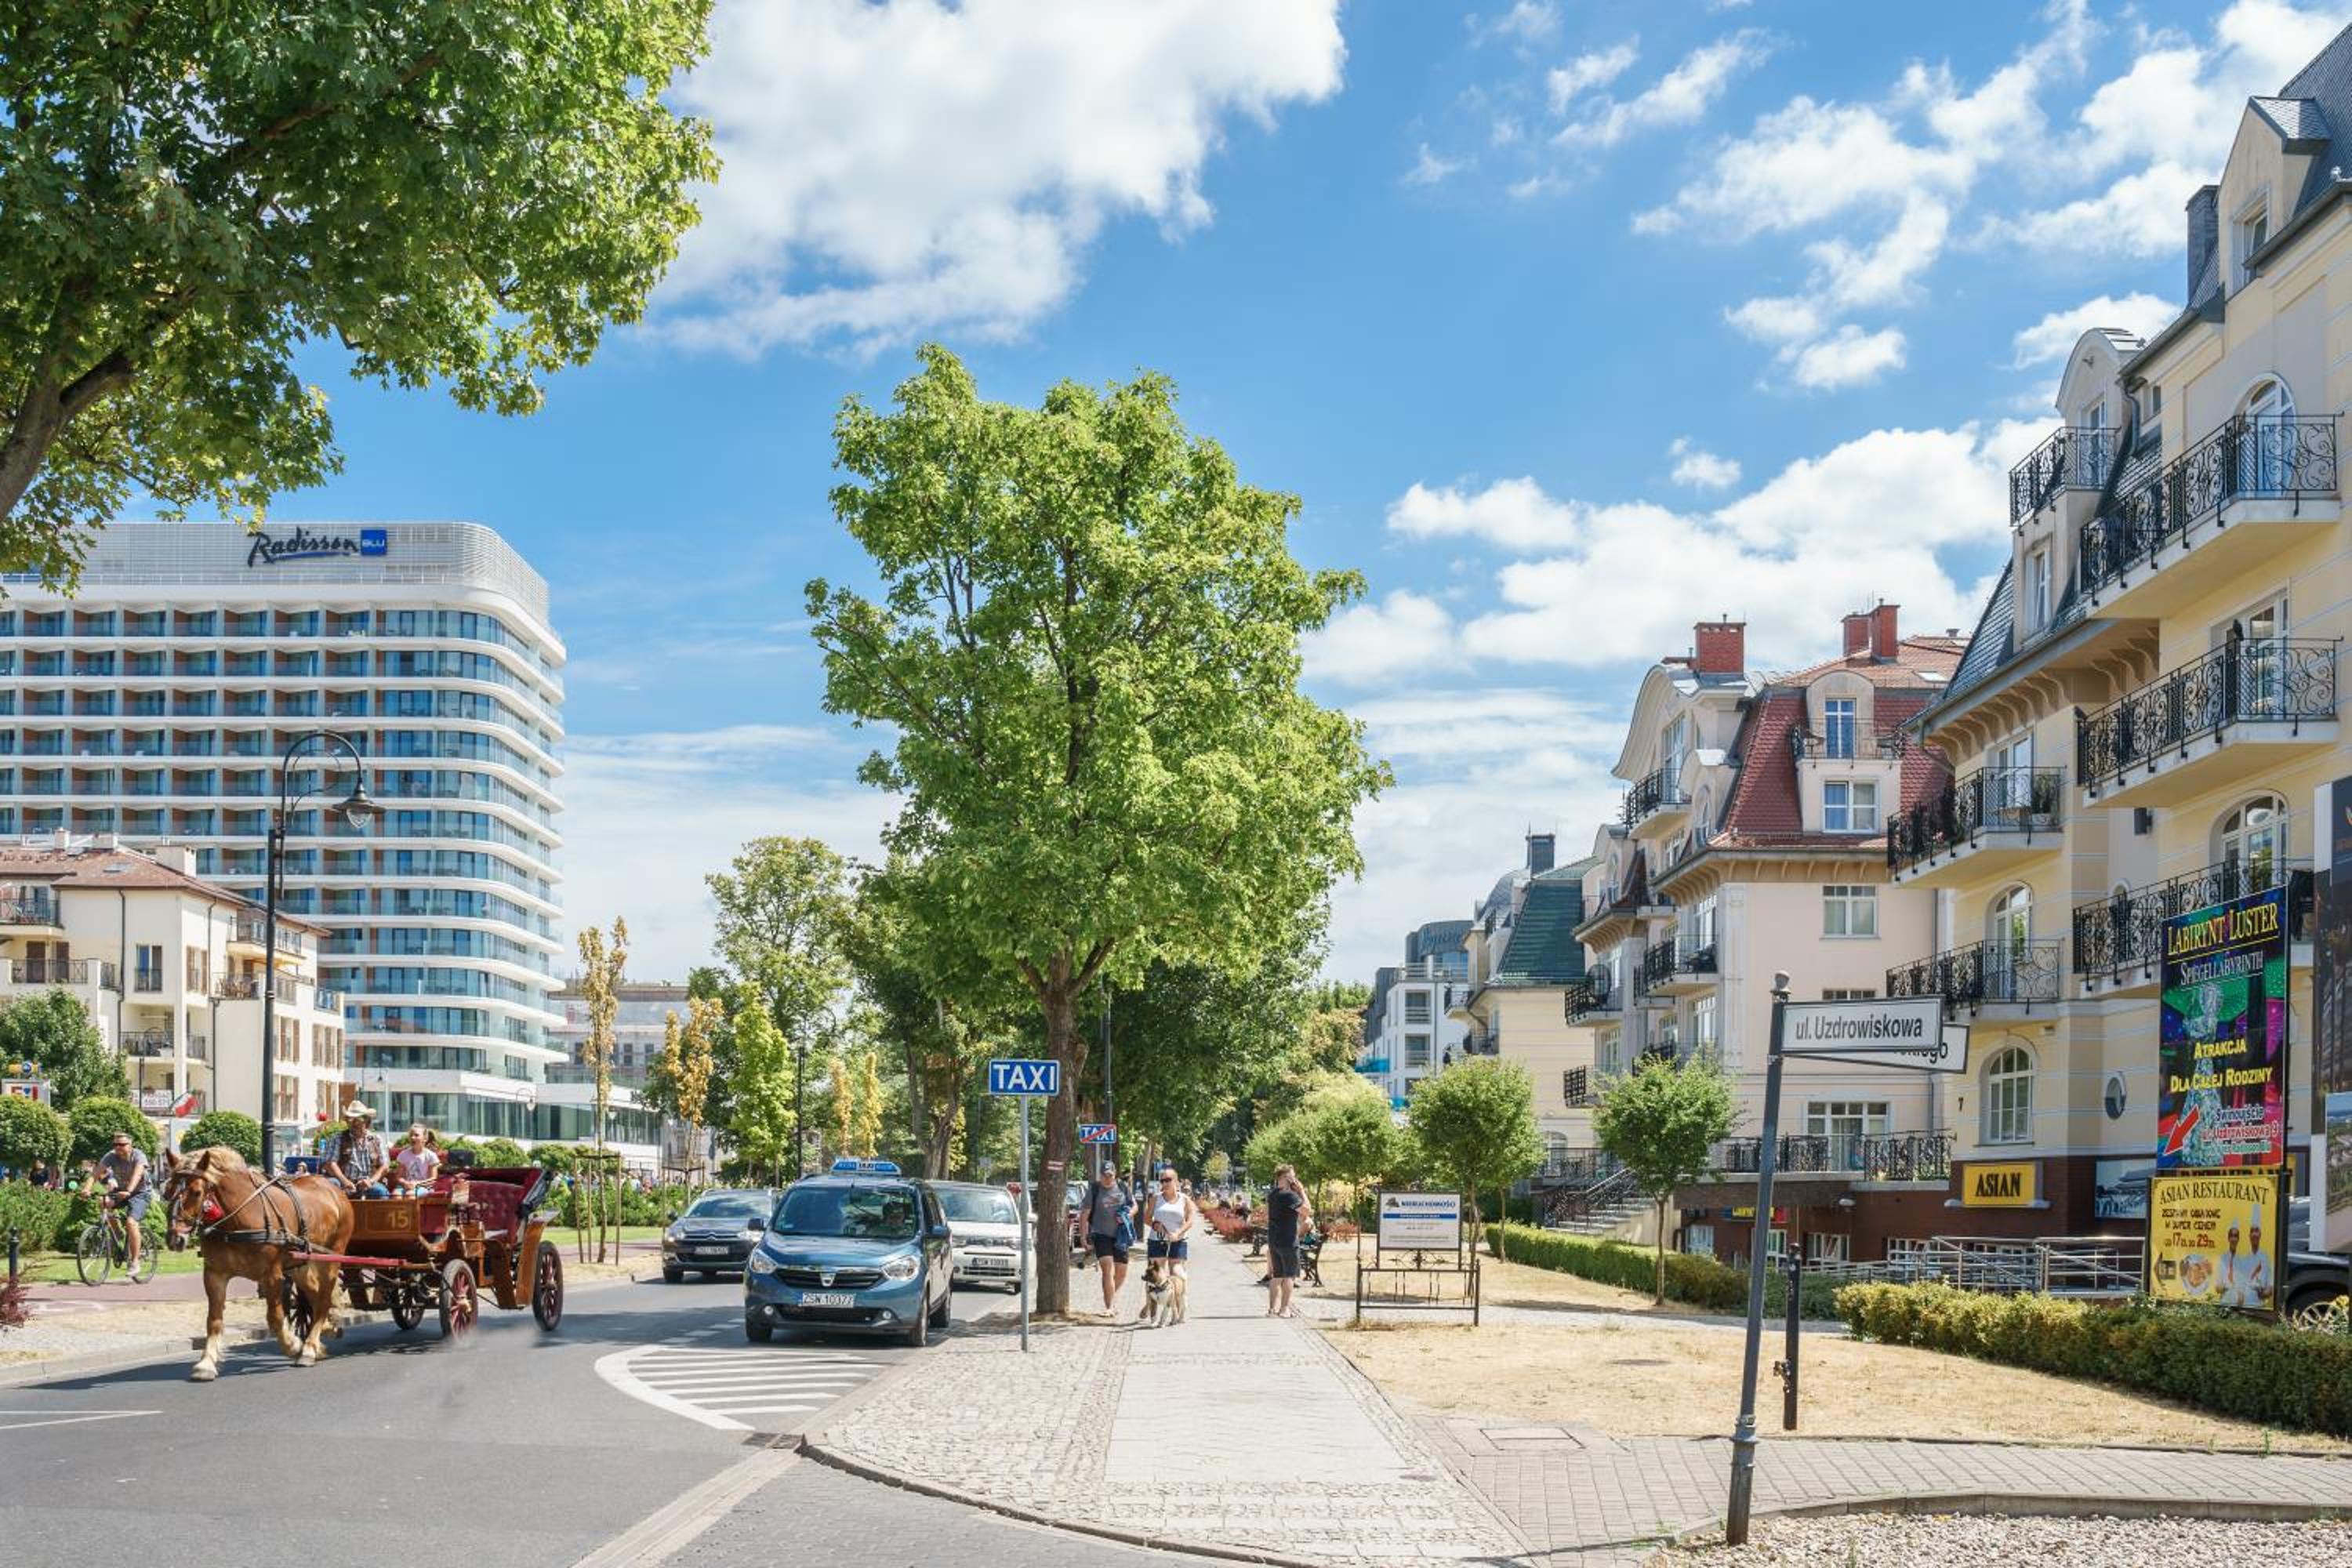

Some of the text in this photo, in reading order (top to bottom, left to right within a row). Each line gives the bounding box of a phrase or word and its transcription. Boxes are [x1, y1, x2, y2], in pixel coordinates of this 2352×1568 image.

[247, 526, 385, 568] Radisson BLU
[2168, 902, 2278, 956] LABIRYNT LUSTER
[2180, 949, 2263, 985] SPIEGELLABYRINTH
[1795, 1013, 1923, 1040] ul. Uzdrowiskowa
[2194, 1038, 2247, 1059] ATRAKCJA
[993, 1064, 1055, 1091] TAXI
[2170, 1075, 2190, 1094] DLA
[2225, 1067, 2274, 1087] RODZINY
[1958, 1097, 1964, 1112] 7
[1080, 1127, 1116, 1141] TAXI
[1976, 1172, 2023, 1198] ASIAN
[2159, 1180, 2270, 1205] ASIAN RESTAURANT
[388, 1210, 408, 1229] 15
